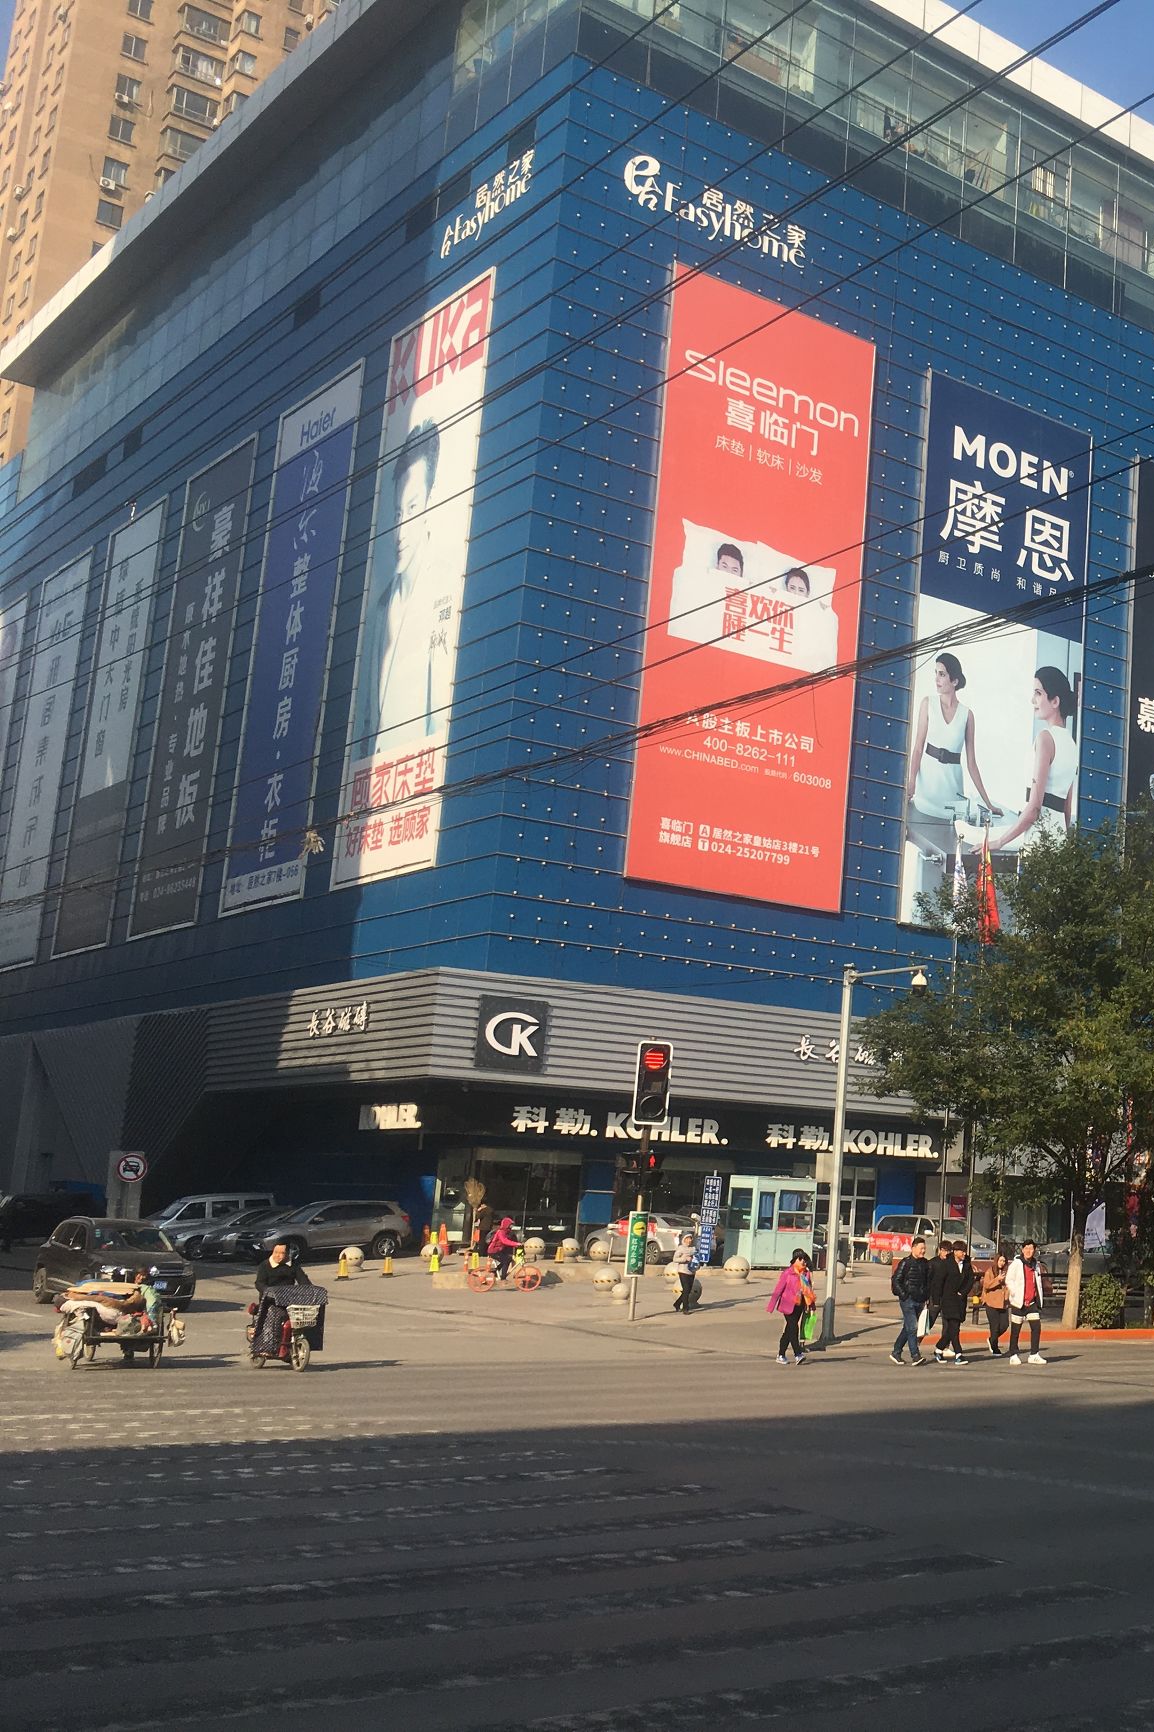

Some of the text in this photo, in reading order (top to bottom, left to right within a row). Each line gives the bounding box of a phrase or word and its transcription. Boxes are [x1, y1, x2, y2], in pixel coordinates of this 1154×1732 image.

[475, 150, 534, 209] 居然之家
[453, 173, 531, 245] Easyhome
[664, 182, 805, 268] Easyhome
[702, 187, 807, 248] 居然之家
[300, 405, 337, 445] Haier
[725, 397, 819, 456] 喜临门
[714, 434, 824, 486] 床垫 软床 沙发
[952, 425, 1069, 501] MOEN
[939, 478, 1075, 583] 摩恩
[938, 550, 1001, 583] 厨卫质尚
[722, 611, 793, 655] 睡一生
[724, 586, 795, 631] 喜欢你
[175, 502, 235, 832] 豪祥佳地板
[659, 744, 759, 774] www.CHINABED.com
[793, 771, 832, 790] 603008
[703, 735, 796, 768] 400-8262-111
[351, 747, 436, 812] 顾家床垫
[345, 805, 430, 859] 好床垫 选顾家
[658, 831, 693, 849] 旗舰店
[660, 817, 693, 834] 喜临门
[711, 841, 790, 865] 024-25207799
